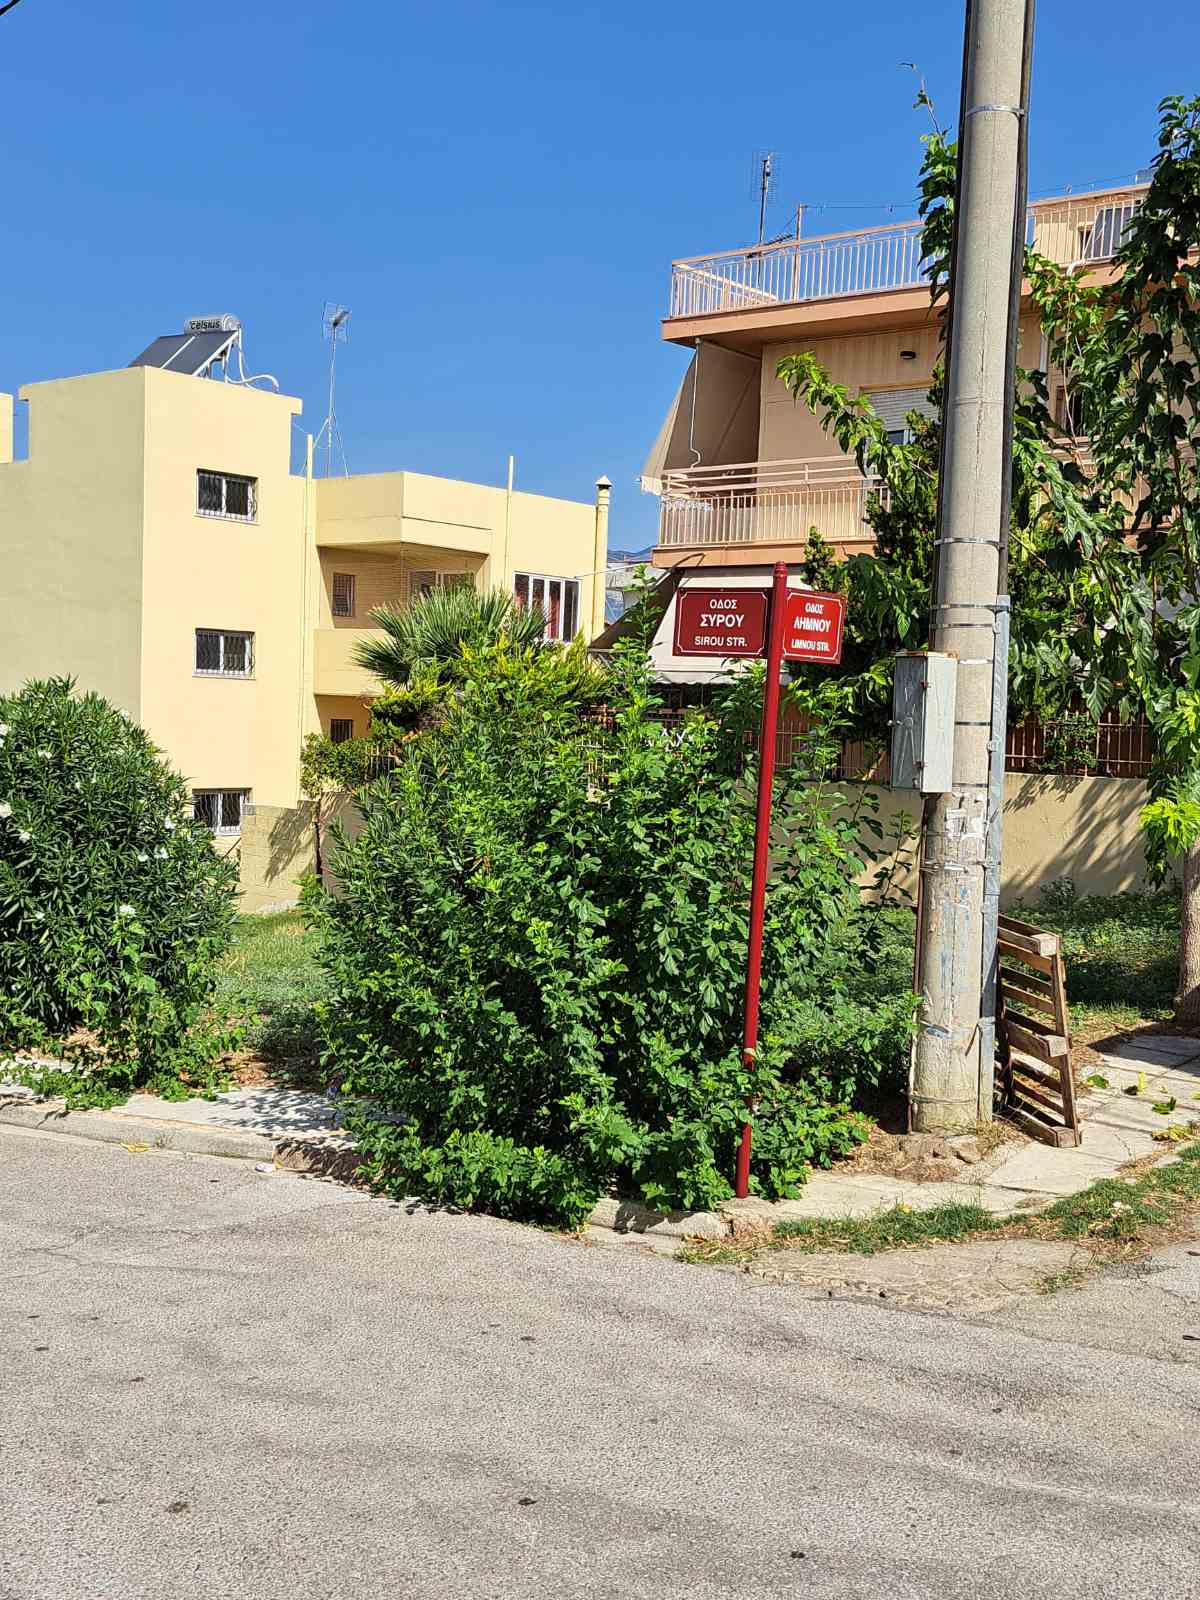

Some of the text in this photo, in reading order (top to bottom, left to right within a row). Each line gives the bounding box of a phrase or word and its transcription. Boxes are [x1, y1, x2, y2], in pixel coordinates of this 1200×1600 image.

[709, 599, 738, 609] ΟΔΟΣ
[804, 602, 825, 614] ΟΔΟΣ
[700, 614, 745, 628] ΣΥΡΟΥ
[793, 616, 831, 632] ΛΗΜΝΟΥ
[694, 635, 748, 647] SIROU STR.
[791, 638, 816, 650] LIMNOU
